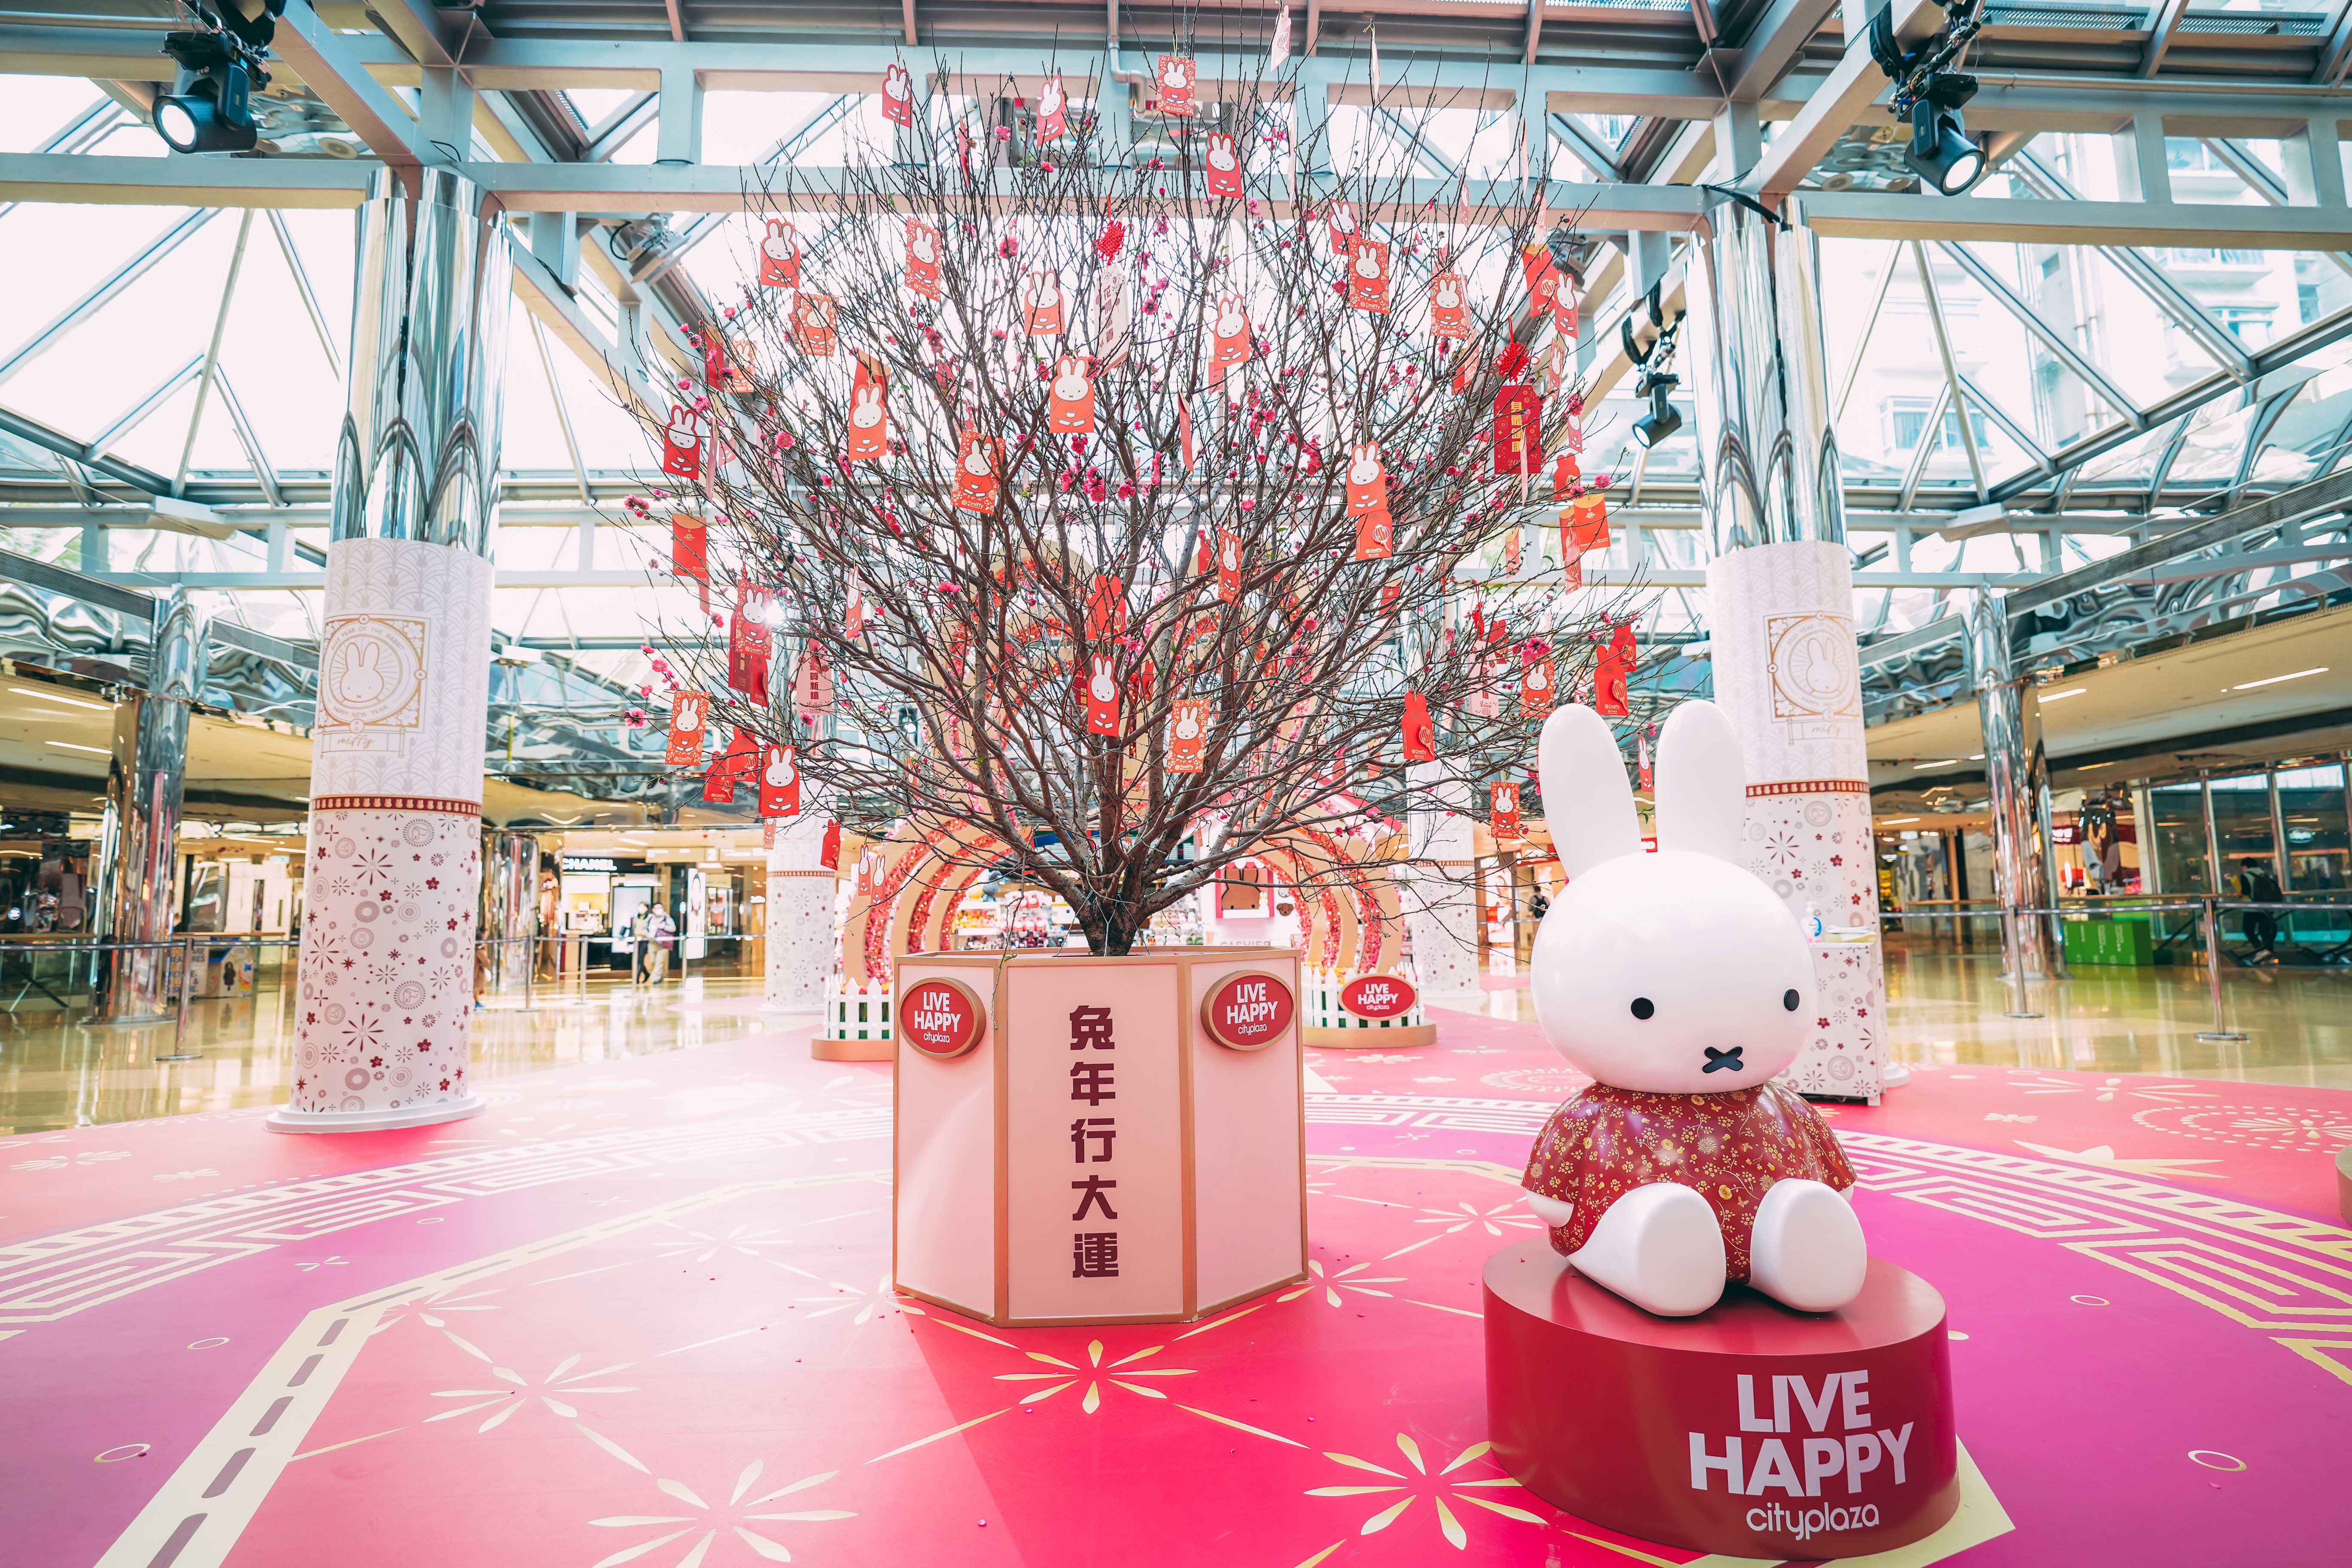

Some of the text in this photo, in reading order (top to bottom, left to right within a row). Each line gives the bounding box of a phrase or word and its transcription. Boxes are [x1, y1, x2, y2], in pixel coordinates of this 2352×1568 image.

[921, 287, 932, 295] miffy
[342, 628, 356, 636] YEAR
[333, 706, 349, 715] HAPPY
[371, 704, 388, 714] YEAR
[337, 734, 375, 749] miffy
[562, 858, 618, 871] CHANEL
[1237, 983, 1266, 1003] LIVE
[1365, 983, 1389, 994] LIVE
[923, 991, 950, 1012] LIVE
[1358, 993, 1399, 1005] HAPPY
[1227, 1001, 1278, 1024] HAPPY
[914, 1010, 961, 1032] HAPPY
[1238, 1023, 1267, 1035] cityplaza
[924, 1031, 950, 1044] cityplaza
[1069, 1005, 1119, 1279] 兔年行大運
[1737, 1369, 1871, 1433] LIVE
[1689, 1421, 1914, 1497] HAPPY
[1746, 1501, 1880, 1541] cityplaza
